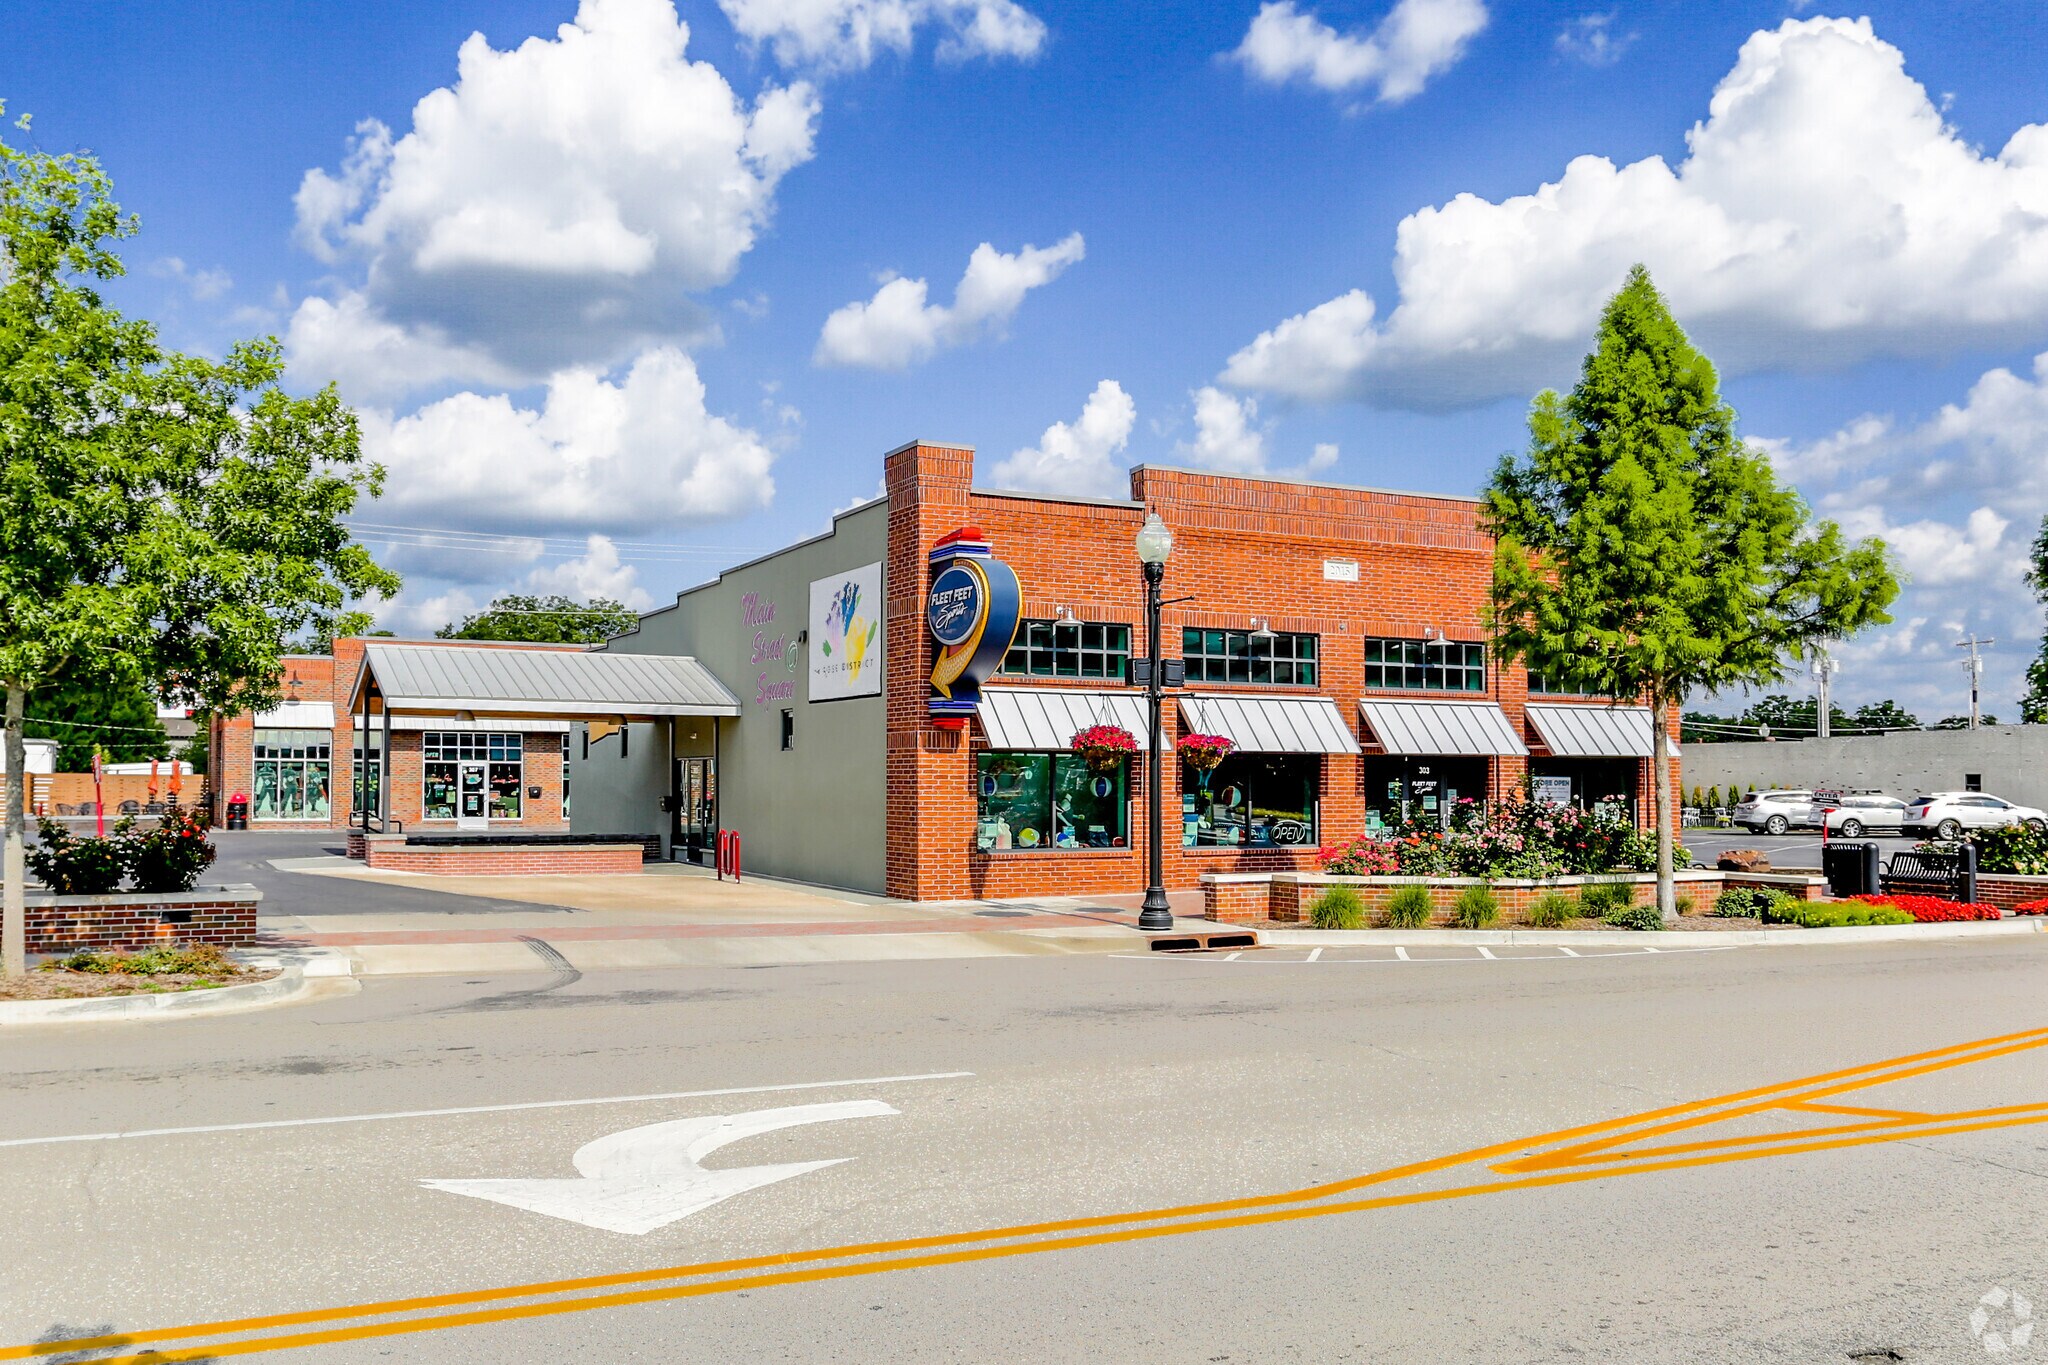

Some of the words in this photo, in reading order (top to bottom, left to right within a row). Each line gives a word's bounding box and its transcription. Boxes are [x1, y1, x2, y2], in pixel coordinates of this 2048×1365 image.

[1330, 565, 1351, 576] 2015
[931, 589, 954, 607] FLEET
[953, 585, 974, 602] FEET
[741, 591, 776, 628] Main
[751, 630, 785, 665] Street
[756, 671, 796, 713] Square
[1418, 766, 1430, 775] 303
[1814, 791, 1838, 799] ENTER
[1273, 826, 1304, 840] OPEN
